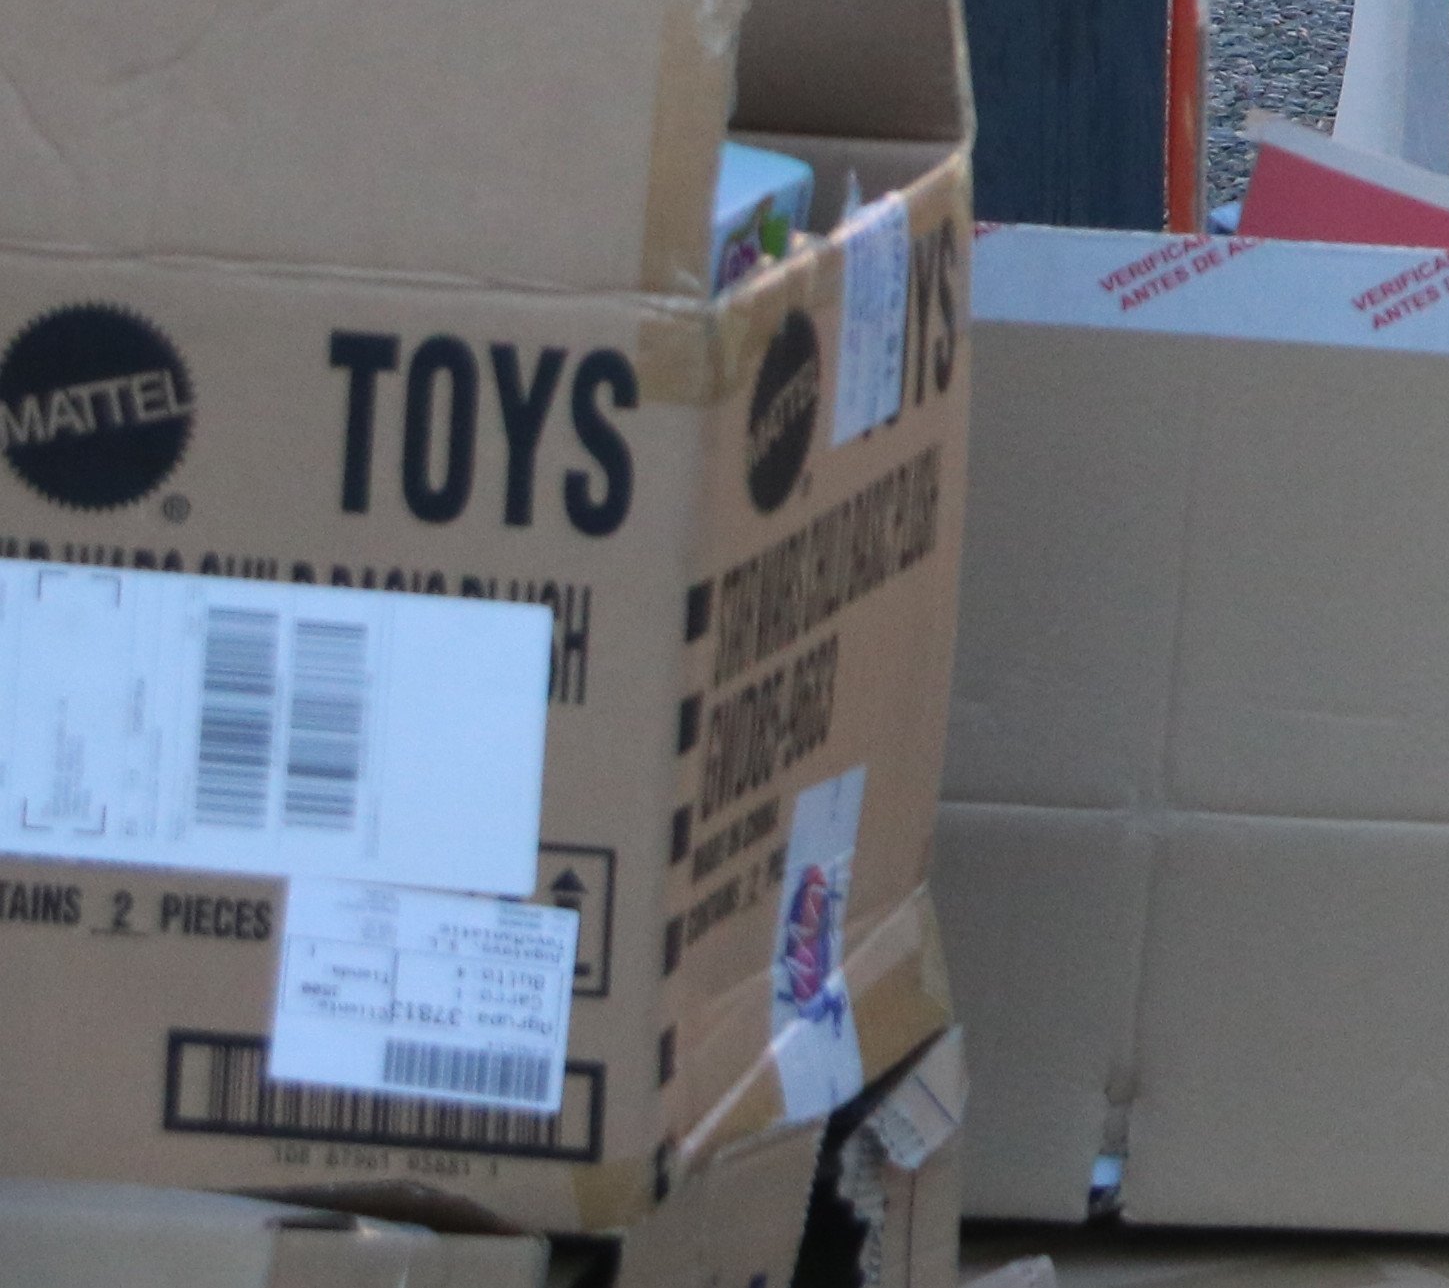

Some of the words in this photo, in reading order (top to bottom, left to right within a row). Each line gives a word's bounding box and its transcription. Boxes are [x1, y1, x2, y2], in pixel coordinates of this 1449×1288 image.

[1119, 268, 1191, 313] ANTES
[1196, 251, 1222, 275] DE
[1372, 283, 1441, 331] ANTES
[0, 368, 196, 447] MATTEL
[328, 328, 641, 539] TOYS
[112, 891, 135, 933] 2
[160, 892, 272, 942] PIECES
